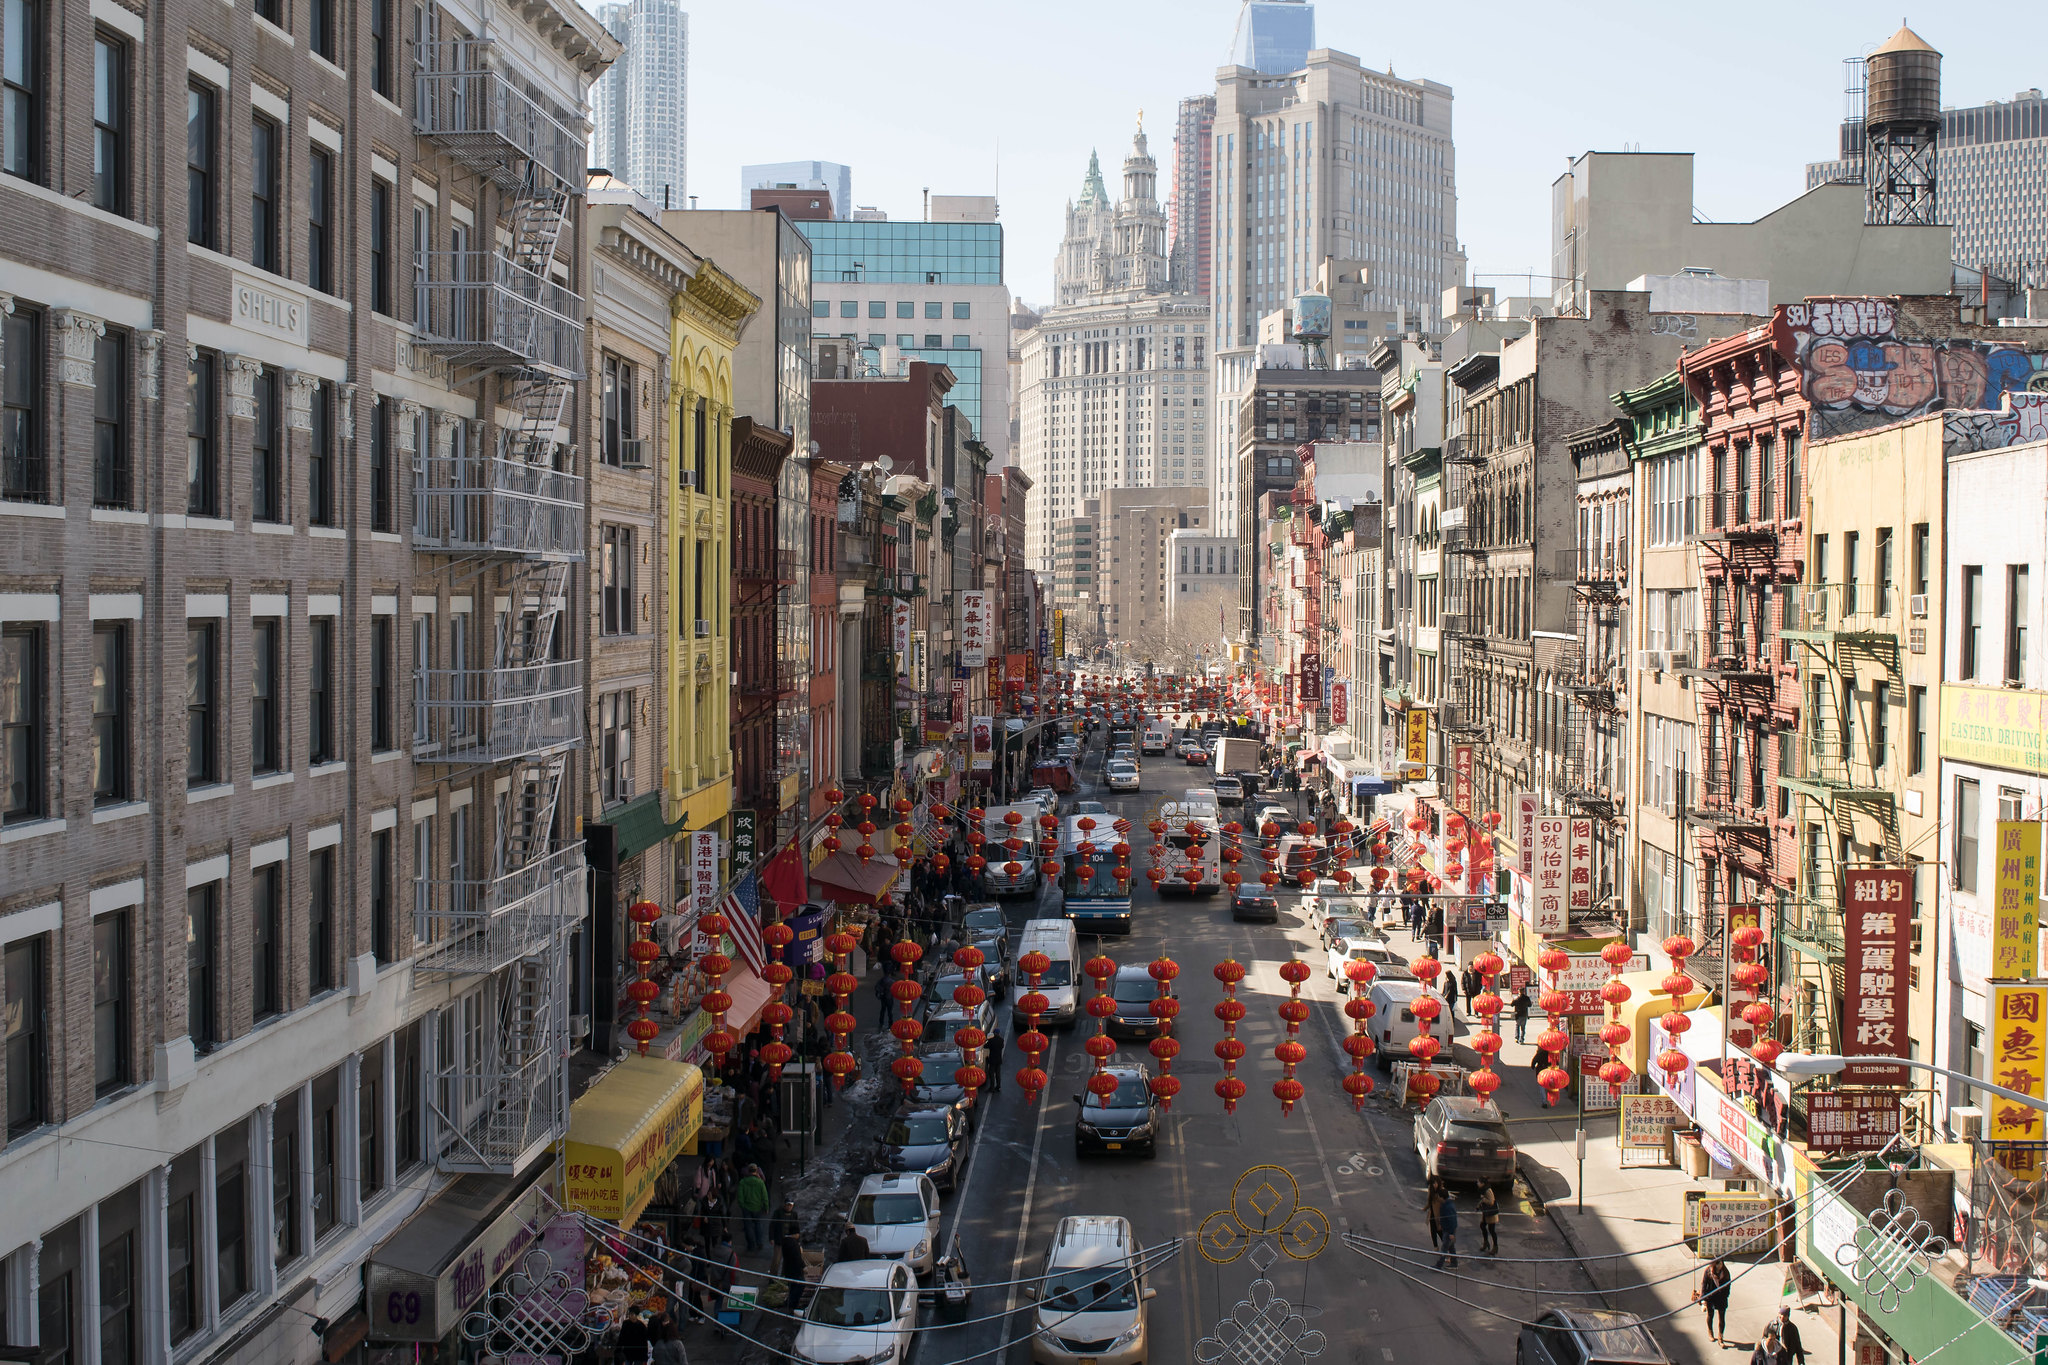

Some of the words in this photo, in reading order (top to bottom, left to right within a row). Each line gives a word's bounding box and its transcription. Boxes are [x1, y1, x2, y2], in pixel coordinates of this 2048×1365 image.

[239, 287, 297, 332] SHEILS
[1951, 721, 1994, 743] EASTERN
[1998, 727, 2041, 749] DRIVING
[1091, 854, 1104, 862] 104
[1854, 878, 1903, 903] 紐約
[1998, 828, 2023, 979] 廣州駕駛學
[1857, 911, 1898, 1048] 第一駕駛學校
[569, 1187, 619, 1201] 福州小吃店
[387, 1291, 421, 1325] 69
